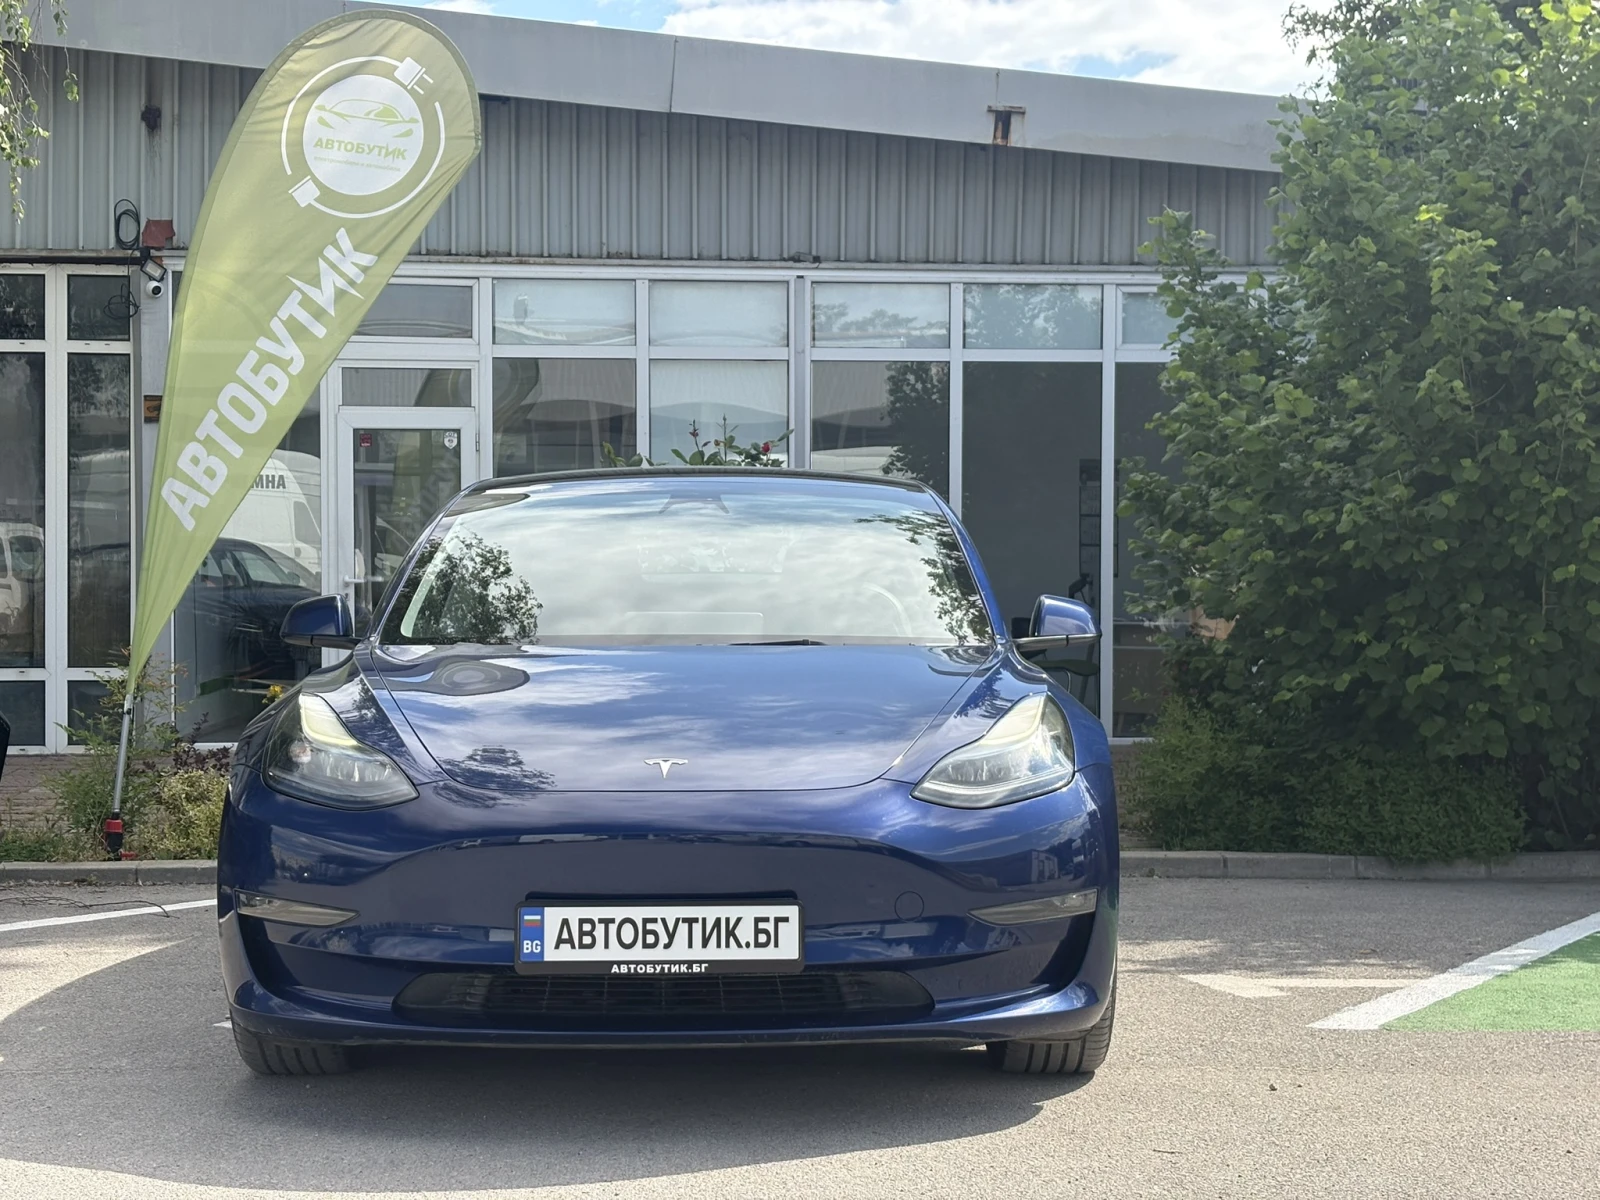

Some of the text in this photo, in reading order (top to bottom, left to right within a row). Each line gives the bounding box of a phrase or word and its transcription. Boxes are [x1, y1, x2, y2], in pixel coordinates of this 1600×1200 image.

[313, 136, 408, 163] АВТОБУТИК
[161, 227, 378, 531] АВТОБУТИК
[523, 940, 541, 953] BG
[554, 916, 790, 950] АВТОБУТИК.БГ
[611, 963, 709, 974] АВТОБУТИК.БГ
